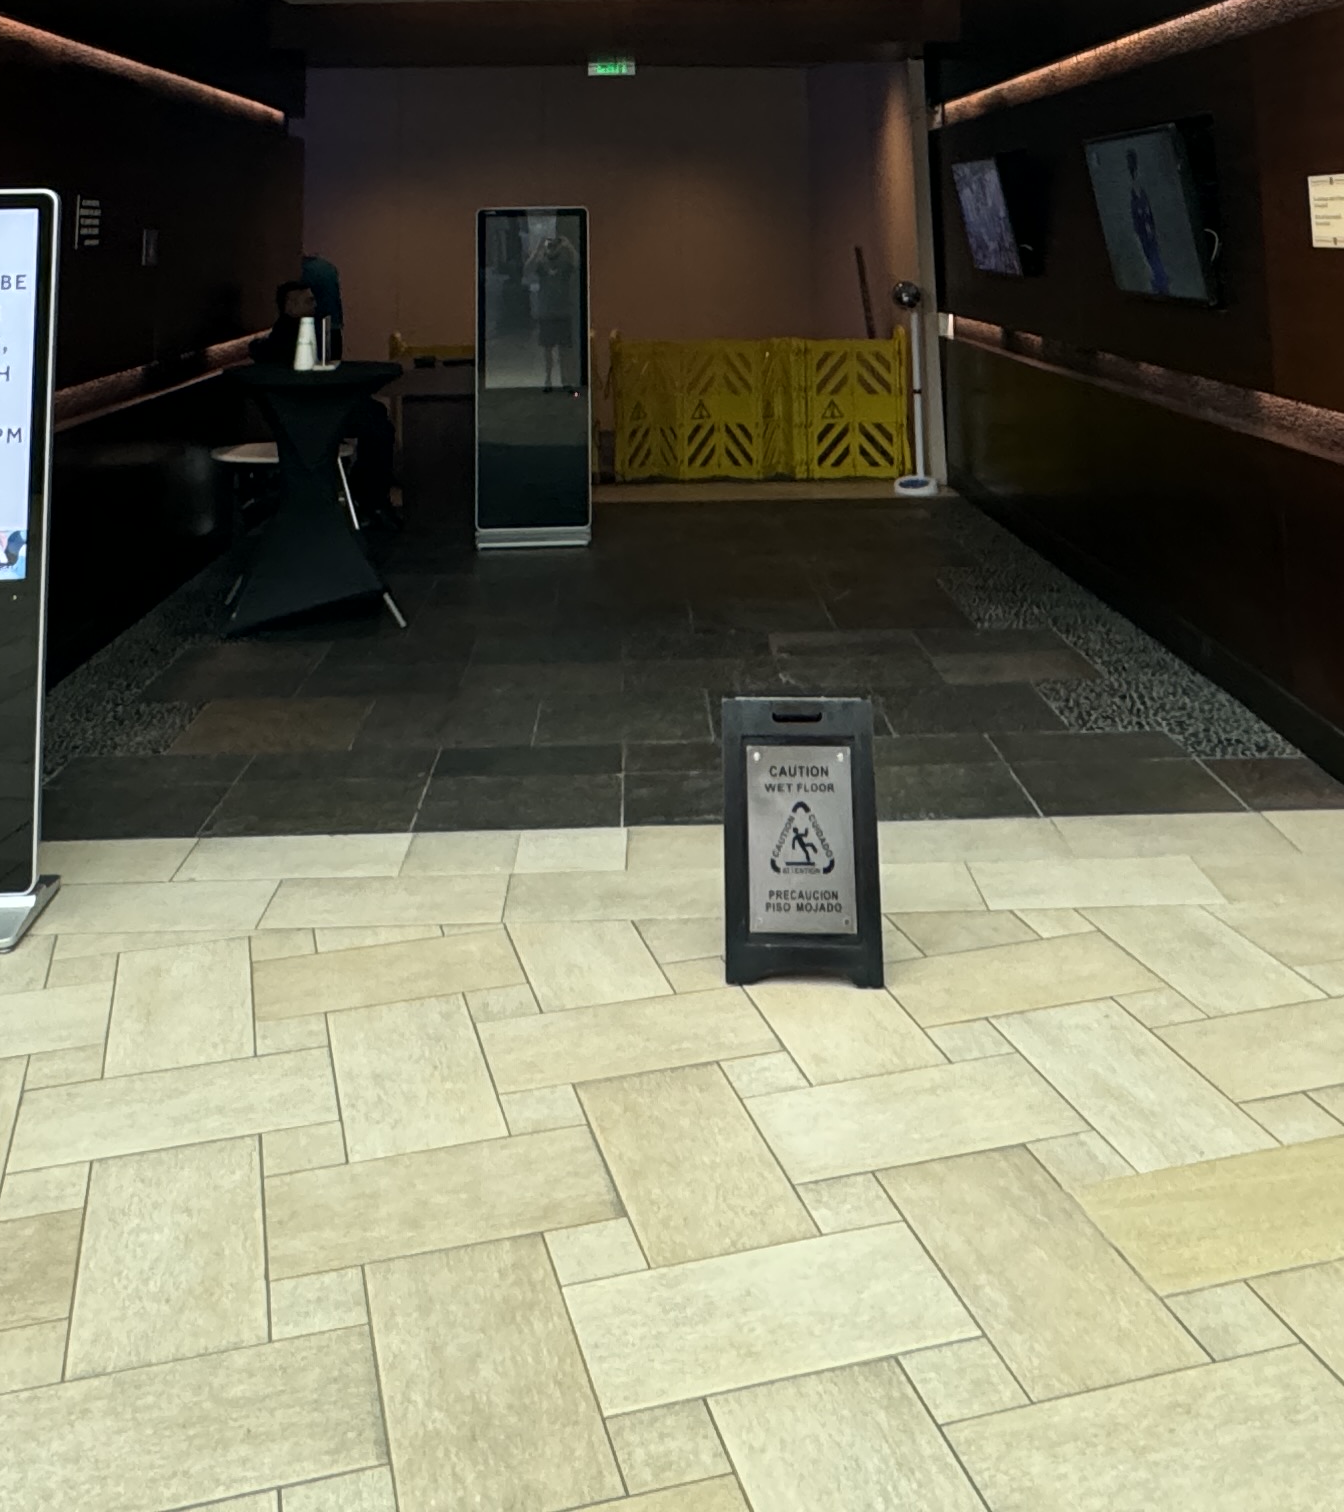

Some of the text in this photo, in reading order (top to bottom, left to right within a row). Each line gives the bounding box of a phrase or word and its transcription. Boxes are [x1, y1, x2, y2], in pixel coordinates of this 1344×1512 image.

[0, 274, 27, 290] BE
[769, 765, 829, 778] CAUTION
[764, 782, 835, 793] WET FLOOR
[772, 814, 796, 858] CAUTION
[808, 813, 833, 858] CUIDADO
[768, 889, 839, 901] PRECAUCION
[765, 901, 843, 913] PISO MOJADO
